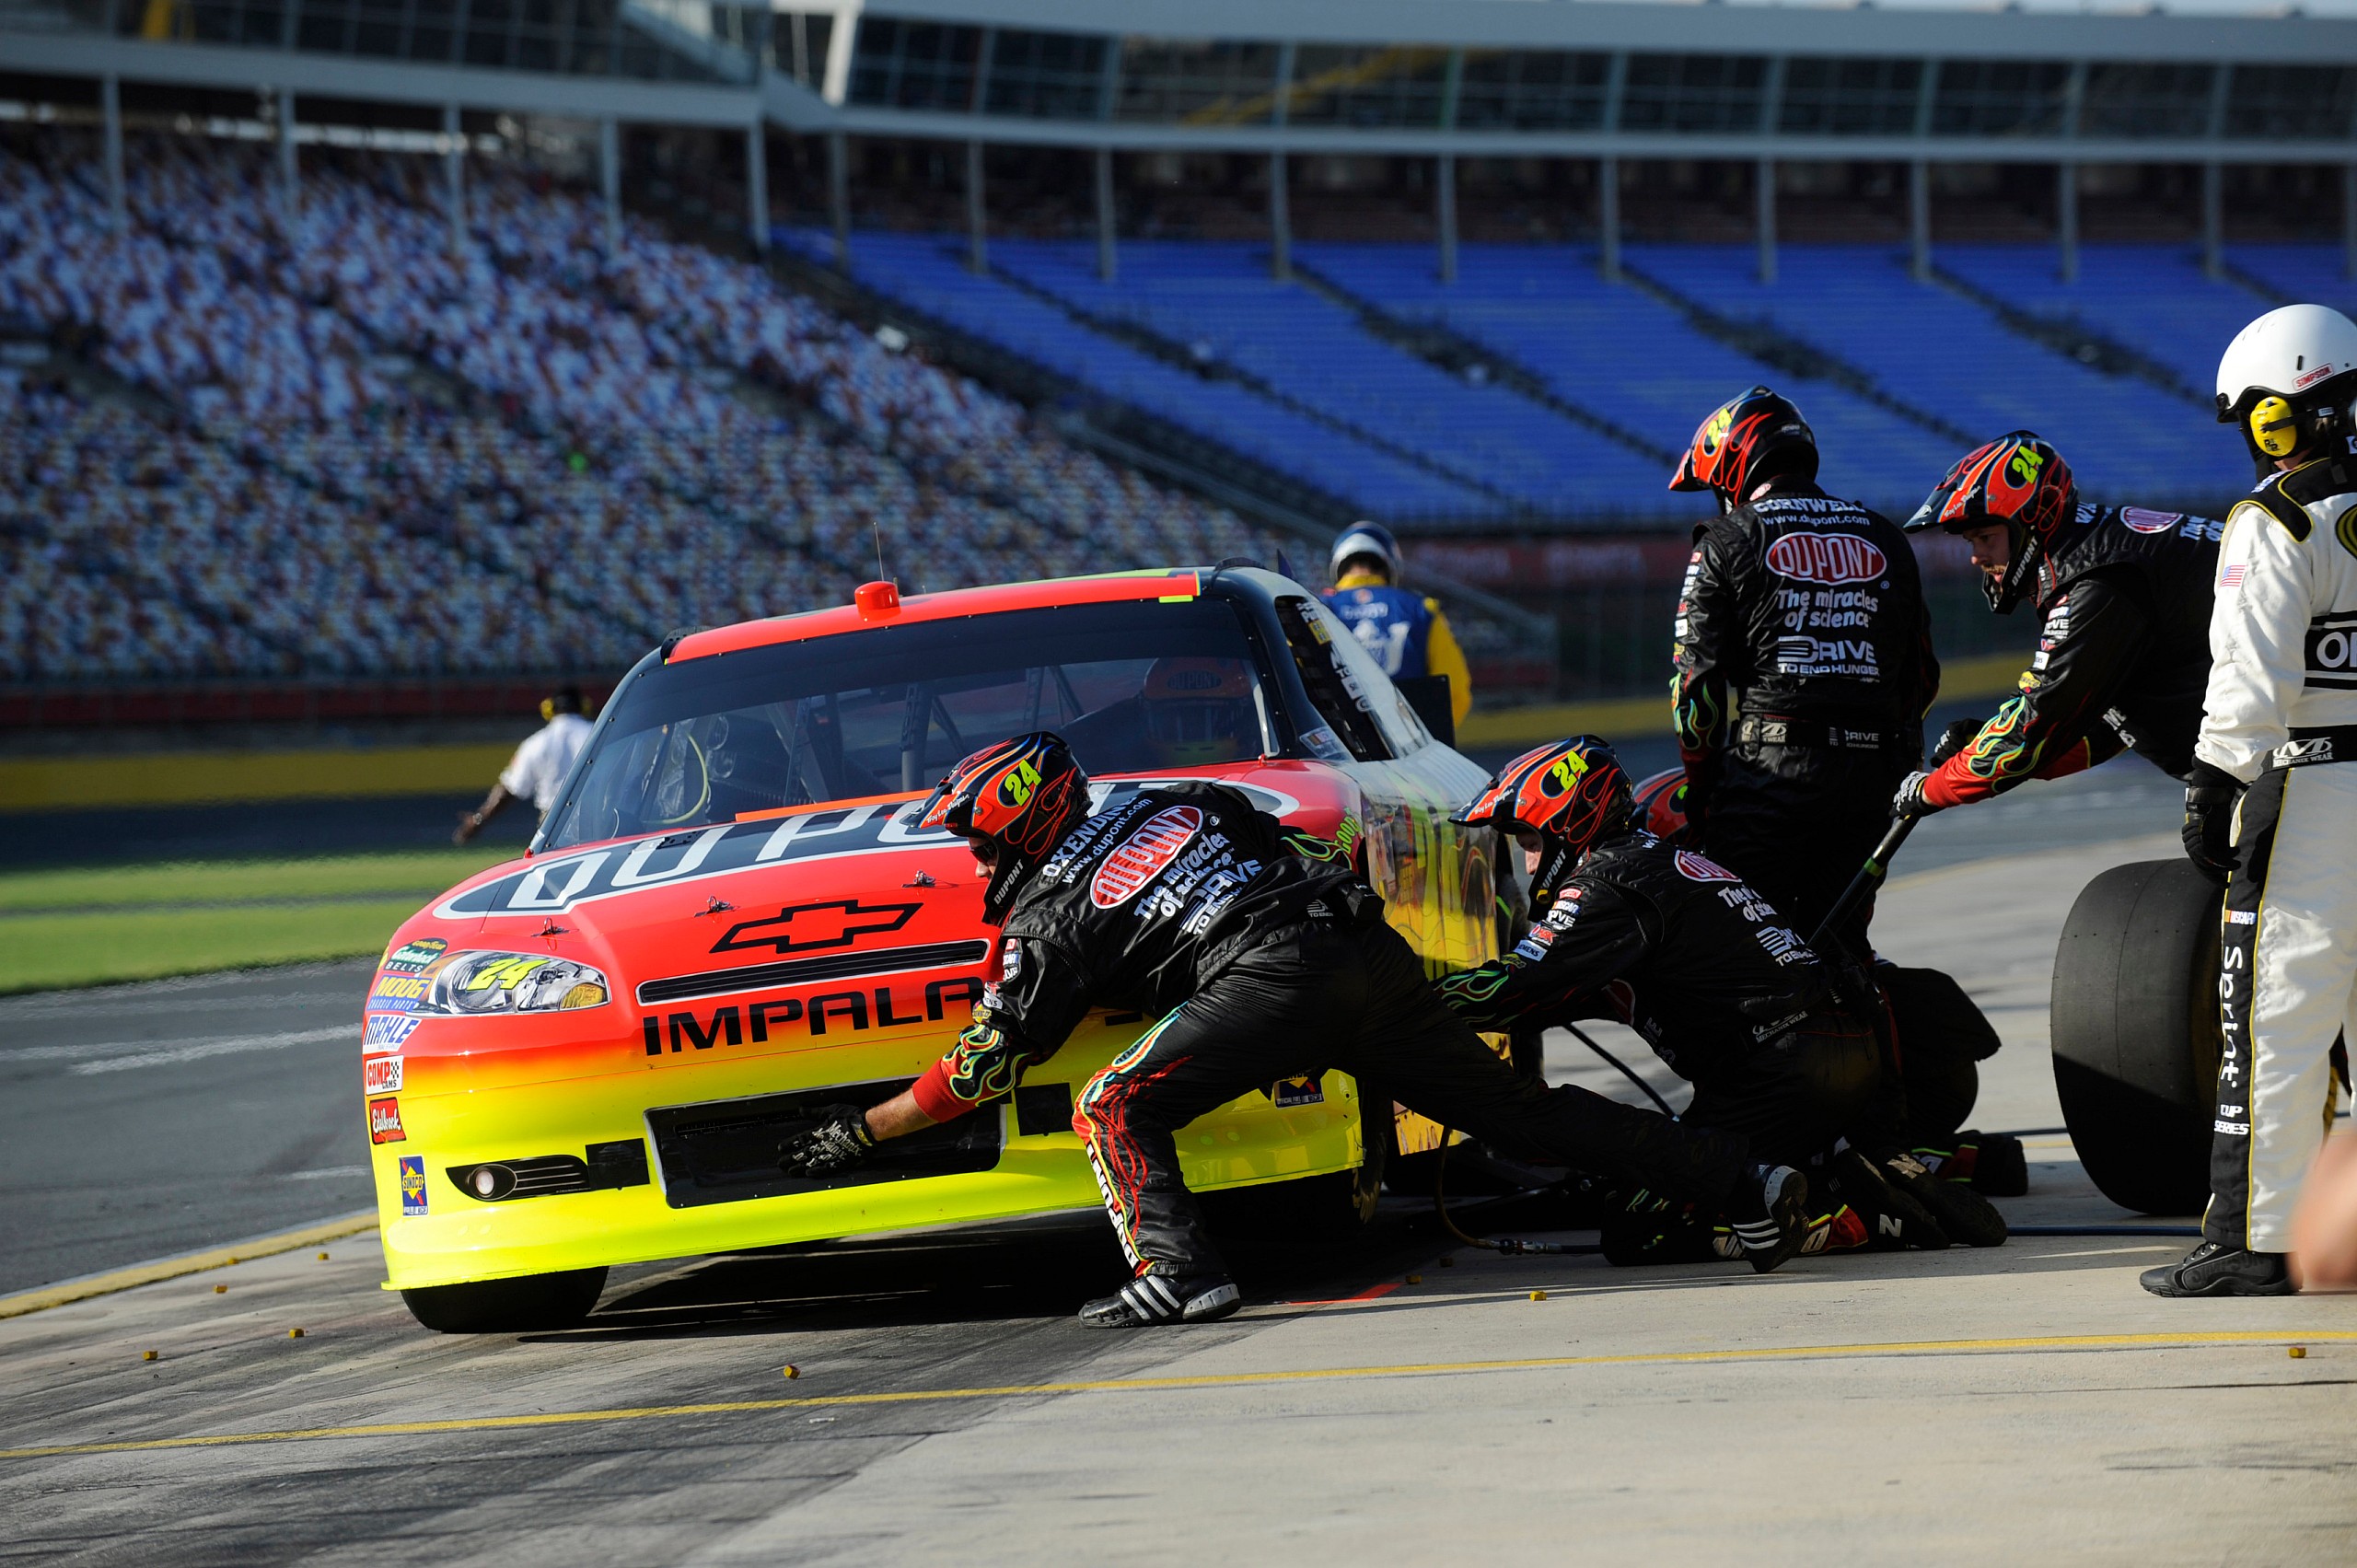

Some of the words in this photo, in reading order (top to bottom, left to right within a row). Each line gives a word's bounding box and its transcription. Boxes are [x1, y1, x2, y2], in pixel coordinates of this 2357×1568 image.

[2013, 446, 2043, 483] 24
[1753, 498, 1866, 513] CORNWELL
[1762, 514, 1870, 527] www.dupont.com
[1777, 537, 1877, 580] DUPONT
[2012, 536, 2038, 587] DUPONT
[1778, 588, 1811, 610] The
[1815, 588, 1878, 612] miracles
[1784, 607, 1809, 633] of
[1809, 609, 1869, 628] science
[1778, 635, 1876, 664] DRIVE
[1778, 663, 1797, 674] TO
[1799, 665, 1830, 674] END
[1831, 664, 1879, 676] HUNGER
[1552, 750, 1589, 792] 24
[2310, 752, 2335, 764] WEAR
[1004, 760, 1042, 807] 24
[926, 813, 939, 824] Troy
[947, 795, 970, 811] Designs
[1062, 798, 1153, 884] www.dupont.com
[1095, 808, 1196, 900] DUPONT
[993, 858, 1025, 905] DUPONT
[1133, 885, 1167, 920] The
[1163, 832, 1231, 885] miracles
[1160, 887, 1184, 917] of
[1193, 915, 1211, 935] TO
[385, 961, 424, 972] BELTS
[466, 958, 552, 991] 24
[375, 976, 430, 999] MOOG
[643, 976, 986, 1056] IMPALA
[1789, 1011, 1809, 1026] WEAR
[2220, 946, 2244, 1087] Sprint
[364, 1016, 419, 1045] MAHLE
[368, 1061, 390, 1086] COMP
[382, 1080, 397, 1089] CAMS
[2220, 1104, 2244, 1118] CUP
[2213, 1121, 2250, 1135] SERIES
[403, 1177, 423, 1189] SUNOCO
[1879, 1214, 1902, 1238] N
